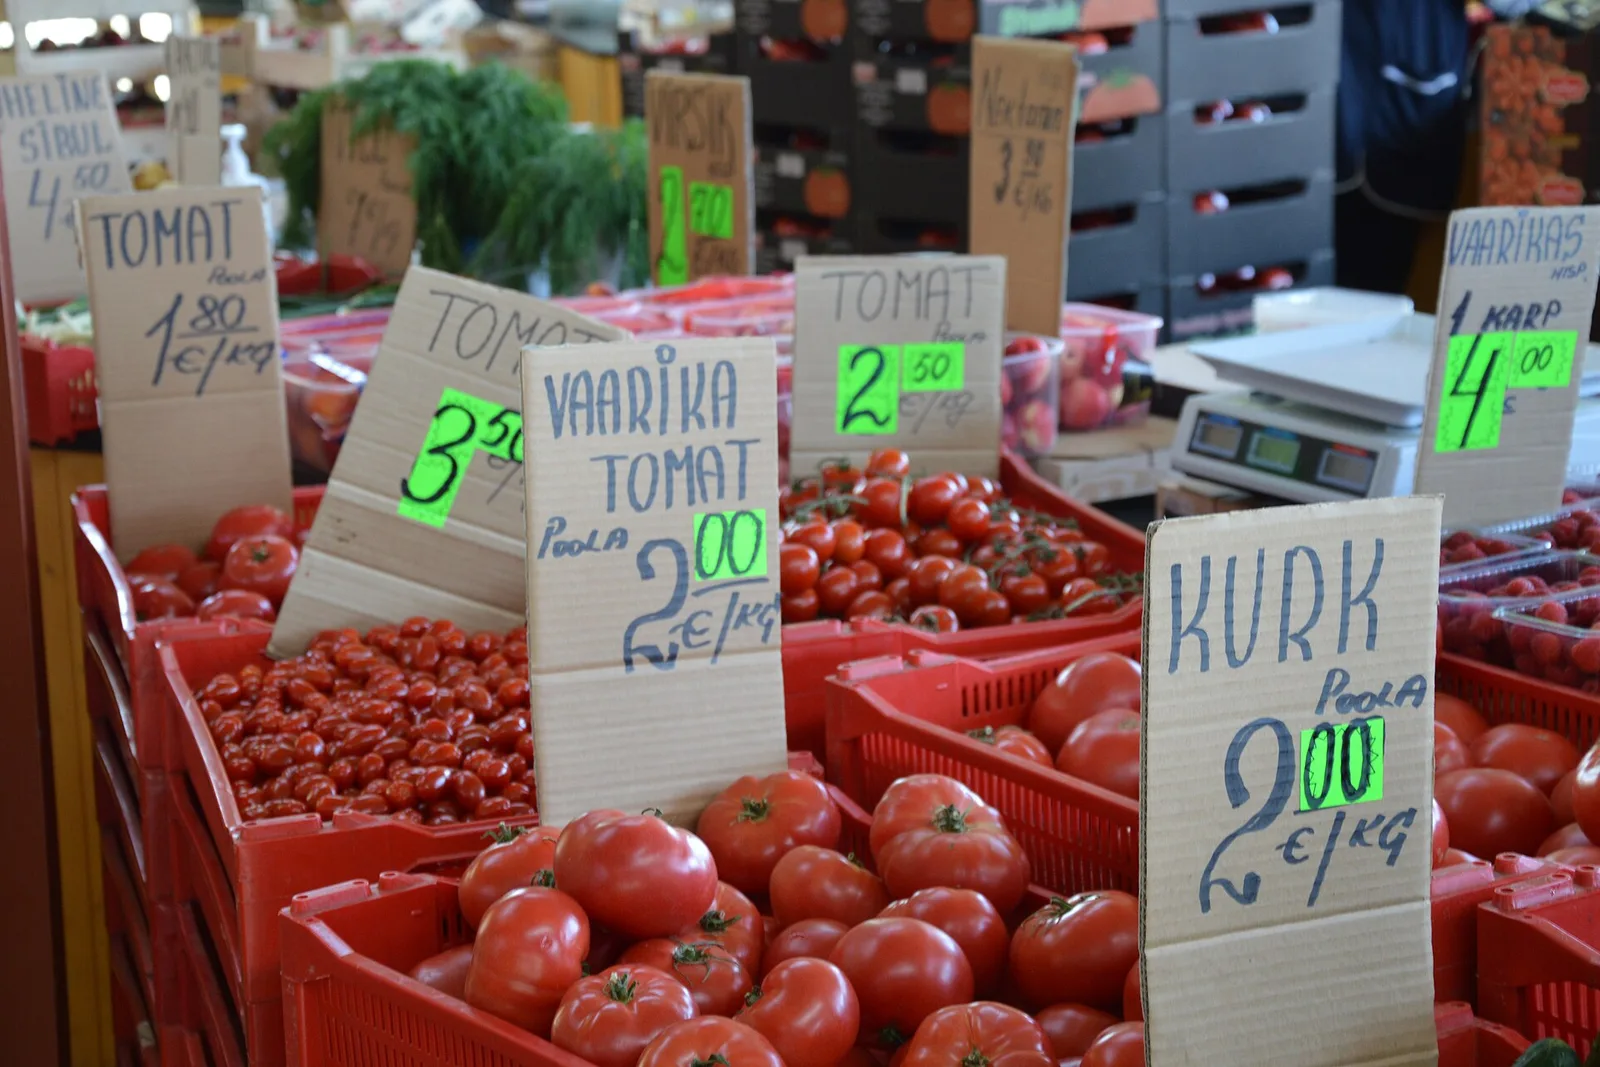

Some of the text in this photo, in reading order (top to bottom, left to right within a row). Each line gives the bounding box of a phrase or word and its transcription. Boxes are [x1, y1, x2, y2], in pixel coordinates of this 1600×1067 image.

[0, 75, 107, 119] HELINE
[28, 168, 61, 240] 4
[74, 162, 110, 190] 50
[89, 200, 242, 270] TOMAT
[1449, 209, 1586, 267] VAARIKAS
[821, 264, 992, 322] TOMAT
[1450, 290, 1562, 336] 1 KARP
[144, 292, 247, 387] 1 80
[544, 344, 737, 439] VAARIKA
[842, 346, 951, 432] 2 50
[1450, 333, 1553, 449] 4 00
[401, 403, 476, 504] 3
[589, 438, 761, 514] TOMAT
[623, 510, 763, 674] 2 00
[1168, 538, 1385, 675] KURK
[1199, 716, 1376, 914] 2 00
